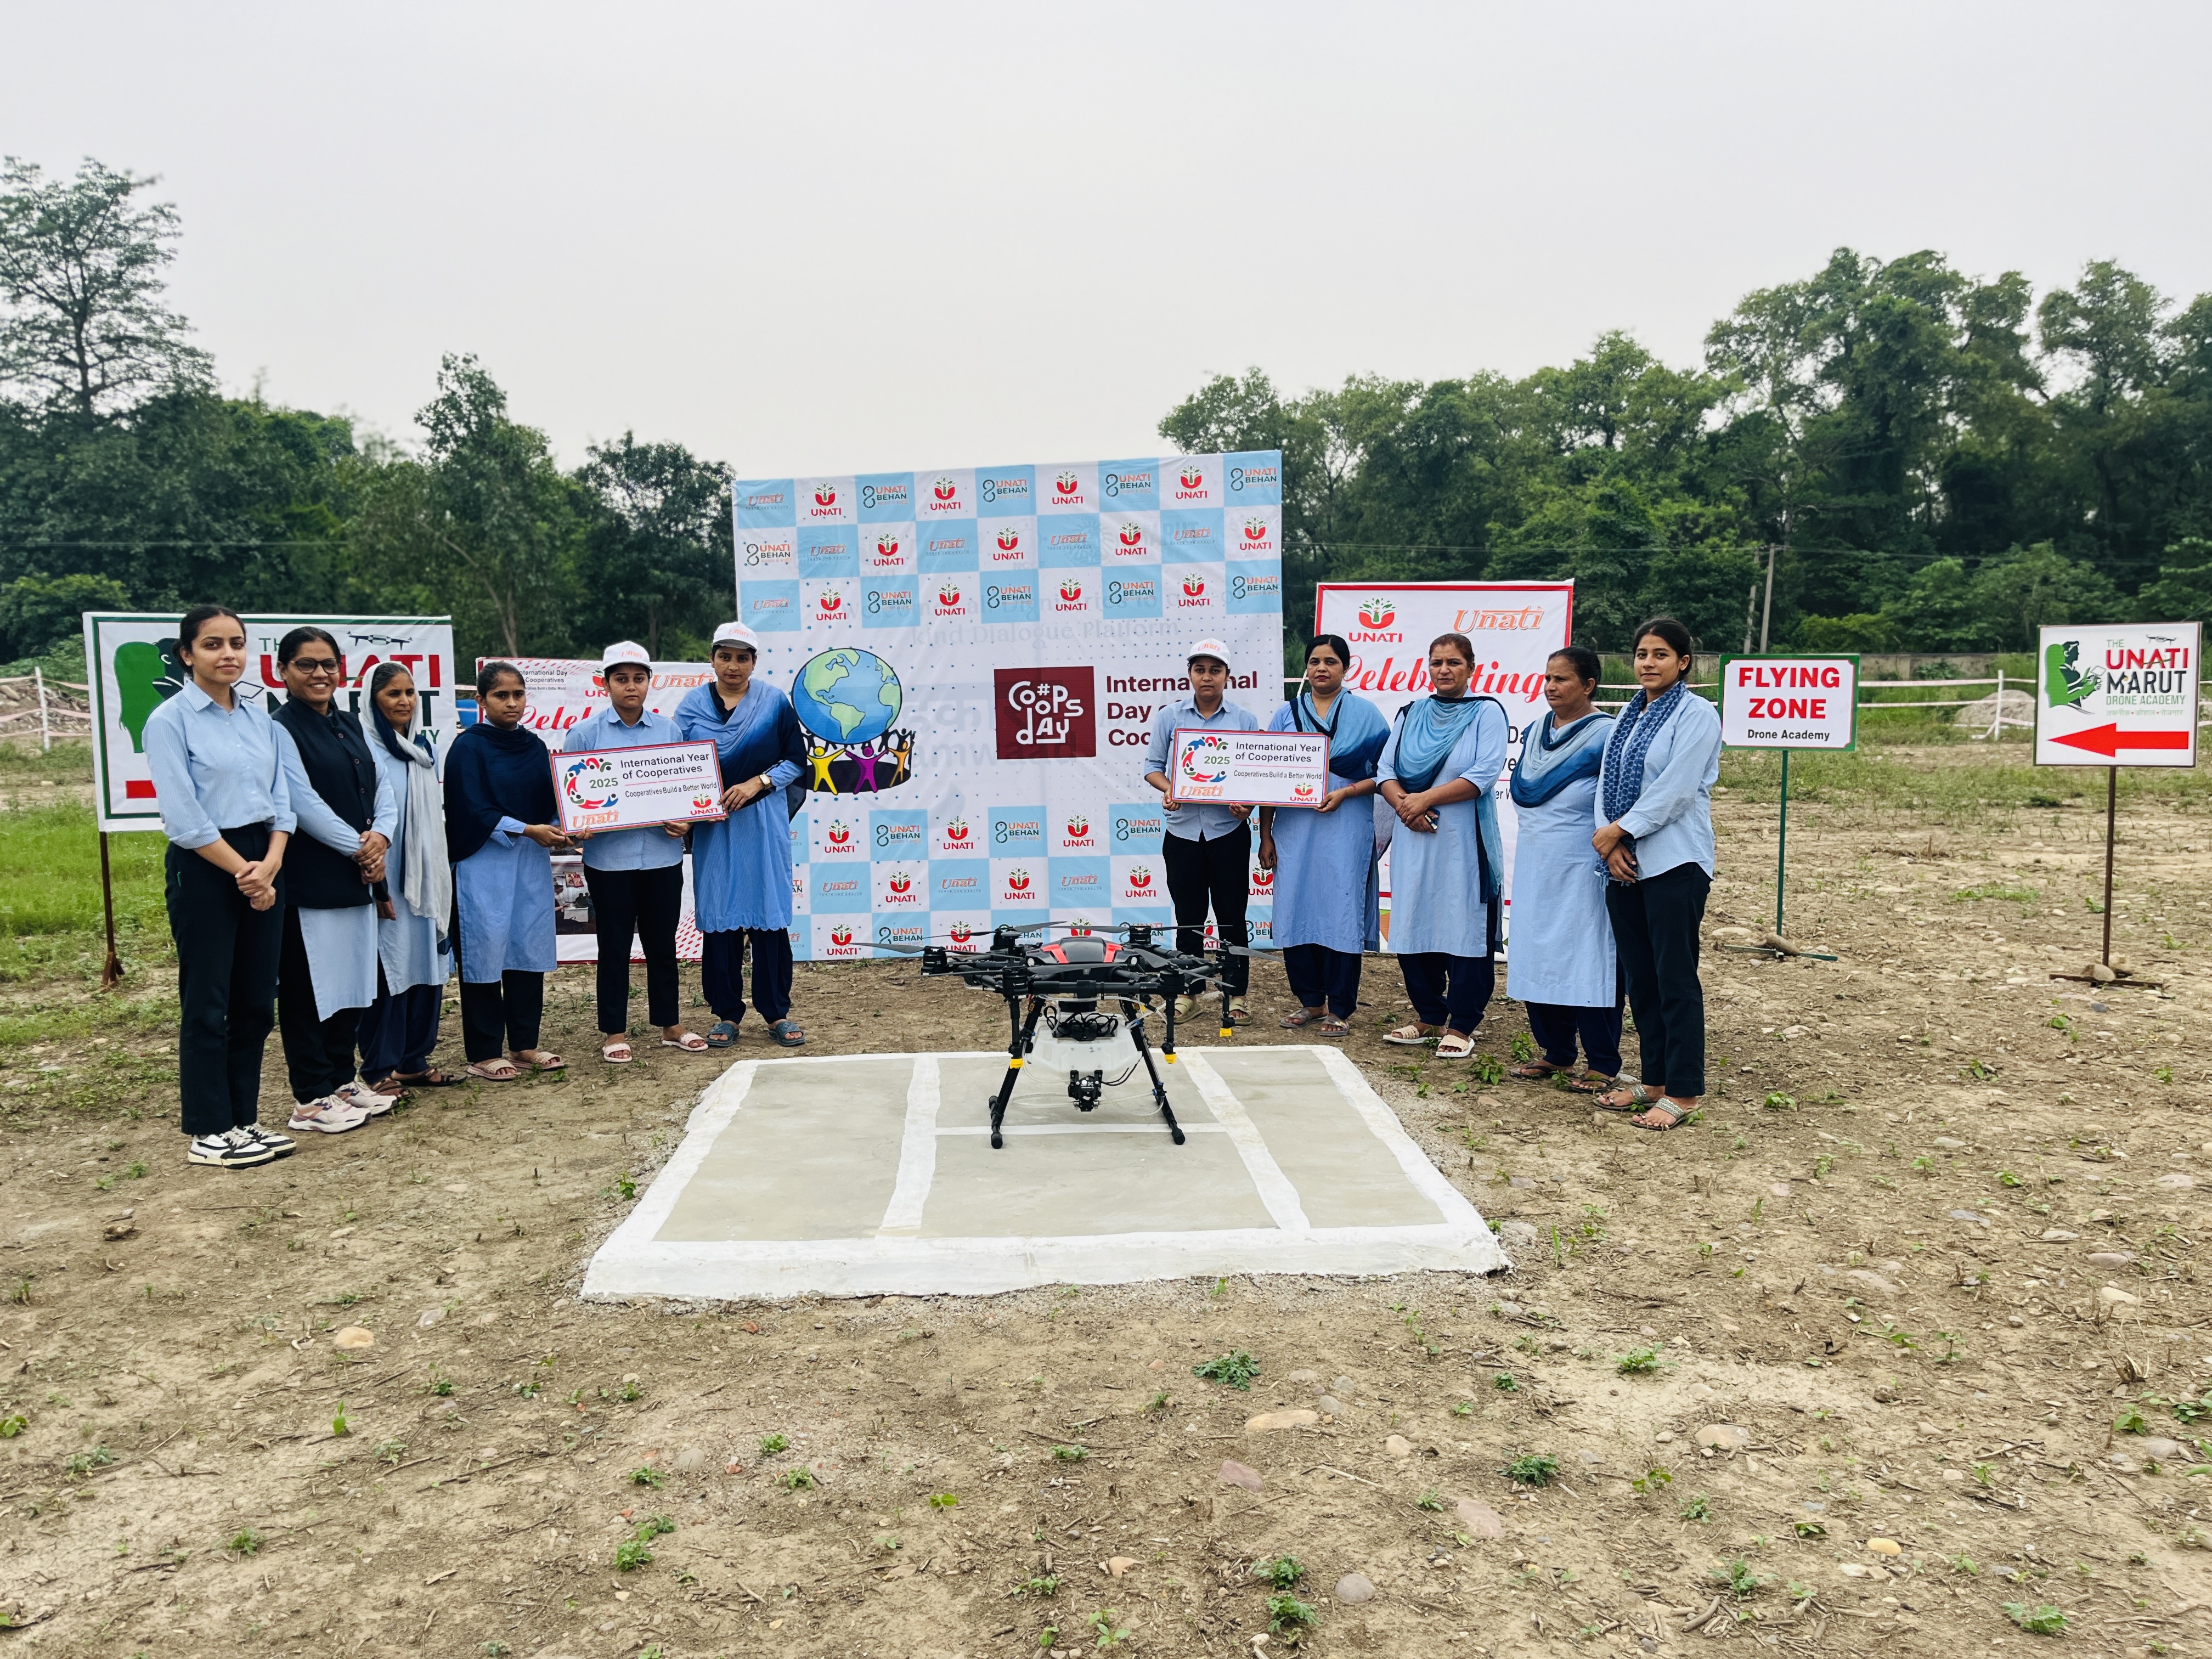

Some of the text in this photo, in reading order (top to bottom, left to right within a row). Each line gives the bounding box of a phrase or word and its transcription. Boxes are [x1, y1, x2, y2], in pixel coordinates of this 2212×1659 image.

[1120, 474, 1150, 482] UNATI
[748, 493, 785, 506] Unati
[1052, 496, 1083, 504] UNATI
[1176, 491, 1207, 499] UNATI
[930, 502, 961, 510] UNATI
[1051, 533, 1087, 545] Unati
[1173, 527, 1211, 541] Unati
[811, 544, 847, 556] Unati
[929, 538, 965, 551] Unati
[1240, 542, 1271, 550] UNATI
[994, 552, 1023, 561] UNATI
[1123, 582, 1154, 590] UNATI
[1248, 584, 1278, 592] BEHAN
[753, 597, 789, 611] Unati
[1179, 598, 1210, 606] UNATI
[817, 612, 847, 620] UNATI
[1453, 606, 1544, 634] Unati
[1348, 632, 1402, 642] UNATI
[2107, 639, 2124, 647] THE
[2106, 648, 2189, 669] UNATI
[651, 673, 715, 690] Unati
[1107, 671, 1257, 693] Internanal
[1344, 656, 1545, 703] Celebting
[1739, 667, 1839, 688] FLYING
[2106, 671, 2187, 694] MARUT
[2106, 695, 2186, 705] DRONE ACADEMY
[1108, 702, 1152, 723] Day
[1748, 698, 1826, 719] ZONE
[1747, 729, 1830, 741] Drone Academy
[1236, 742, 1321, 752] International Year
[620, 753, 709, 768] International Year
[1204, 756, 1230, 764] 2025
[1248, 753, 1312, 763] Cooperatives
[622, 765, 702, 780] of Cooperatives
[590, 777, 618, 789] 2025
[625, 788, 662, 798] Cooperatives
[663, 786, 677, 795] Build
[683, 783, 699, 793] Better
[701, 781, 717, 791] World
[1180, 786, 1224, 797] Unati
[573, 810, 619, 828] Unati
[941, 877, 978, 889] Unati
[1062, 874, 1098, 886] Unati
[822, 880, 859, 893] Unati
